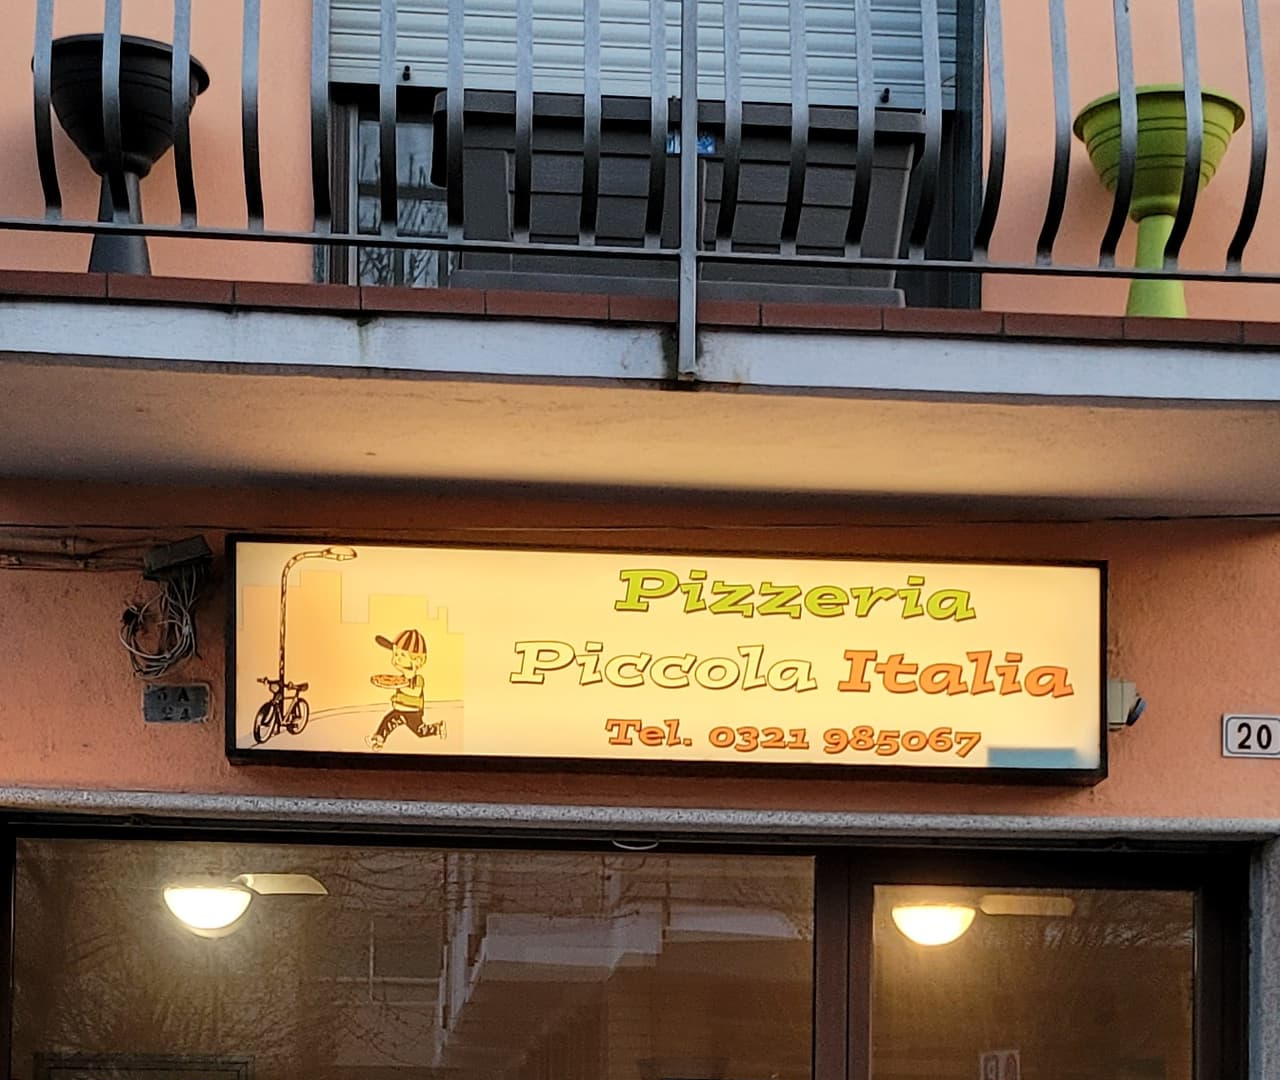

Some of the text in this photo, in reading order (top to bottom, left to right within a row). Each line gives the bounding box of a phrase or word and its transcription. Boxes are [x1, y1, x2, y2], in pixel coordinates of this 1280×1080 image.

[614, 568, 977, 622] Pizzeria
[509, 640, 1075, 698] Piccola Italia
[605, 718, 982, 758] Tel. 0321 985067
[1237, 722, 1272, 750] 20
